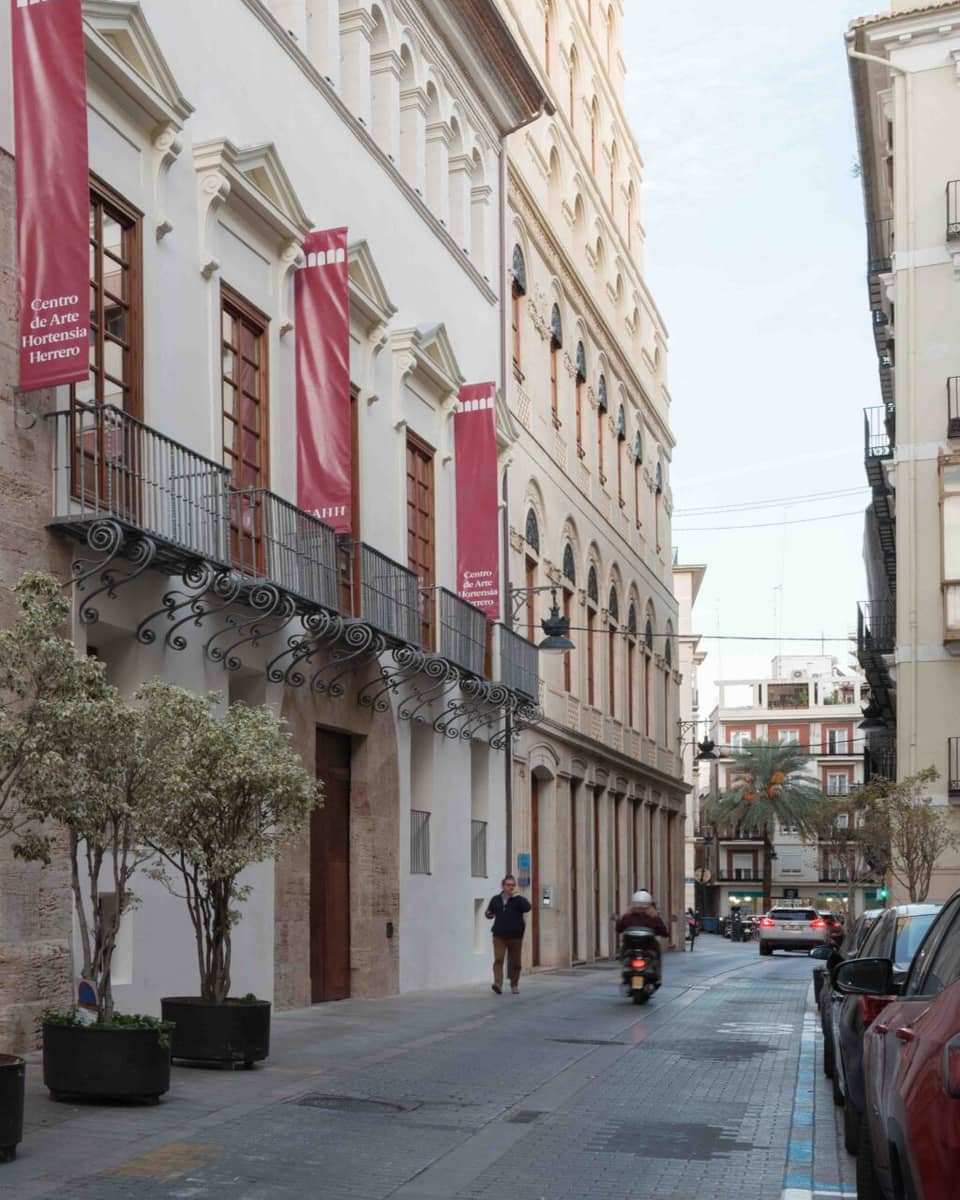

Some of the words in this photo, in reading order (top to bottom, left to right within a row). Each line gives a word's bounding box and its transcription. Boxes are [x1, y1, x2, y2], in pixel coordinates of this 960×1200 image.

[31, 295, 79, 311] Centro
[30, 317, 47, 329] de
[49, 312, 80, 327] Arte
[22, 326, 88, 348] Hortensia
[29, 346, 80, 364] Herrero
[304, 505, 345, 519] AHH
[463, 570, 493, 579] Centro
[463, 581, 474, 589] de
[475, 580, 493, 588] Arte
[458, 589, 498, 598] Hortensia
